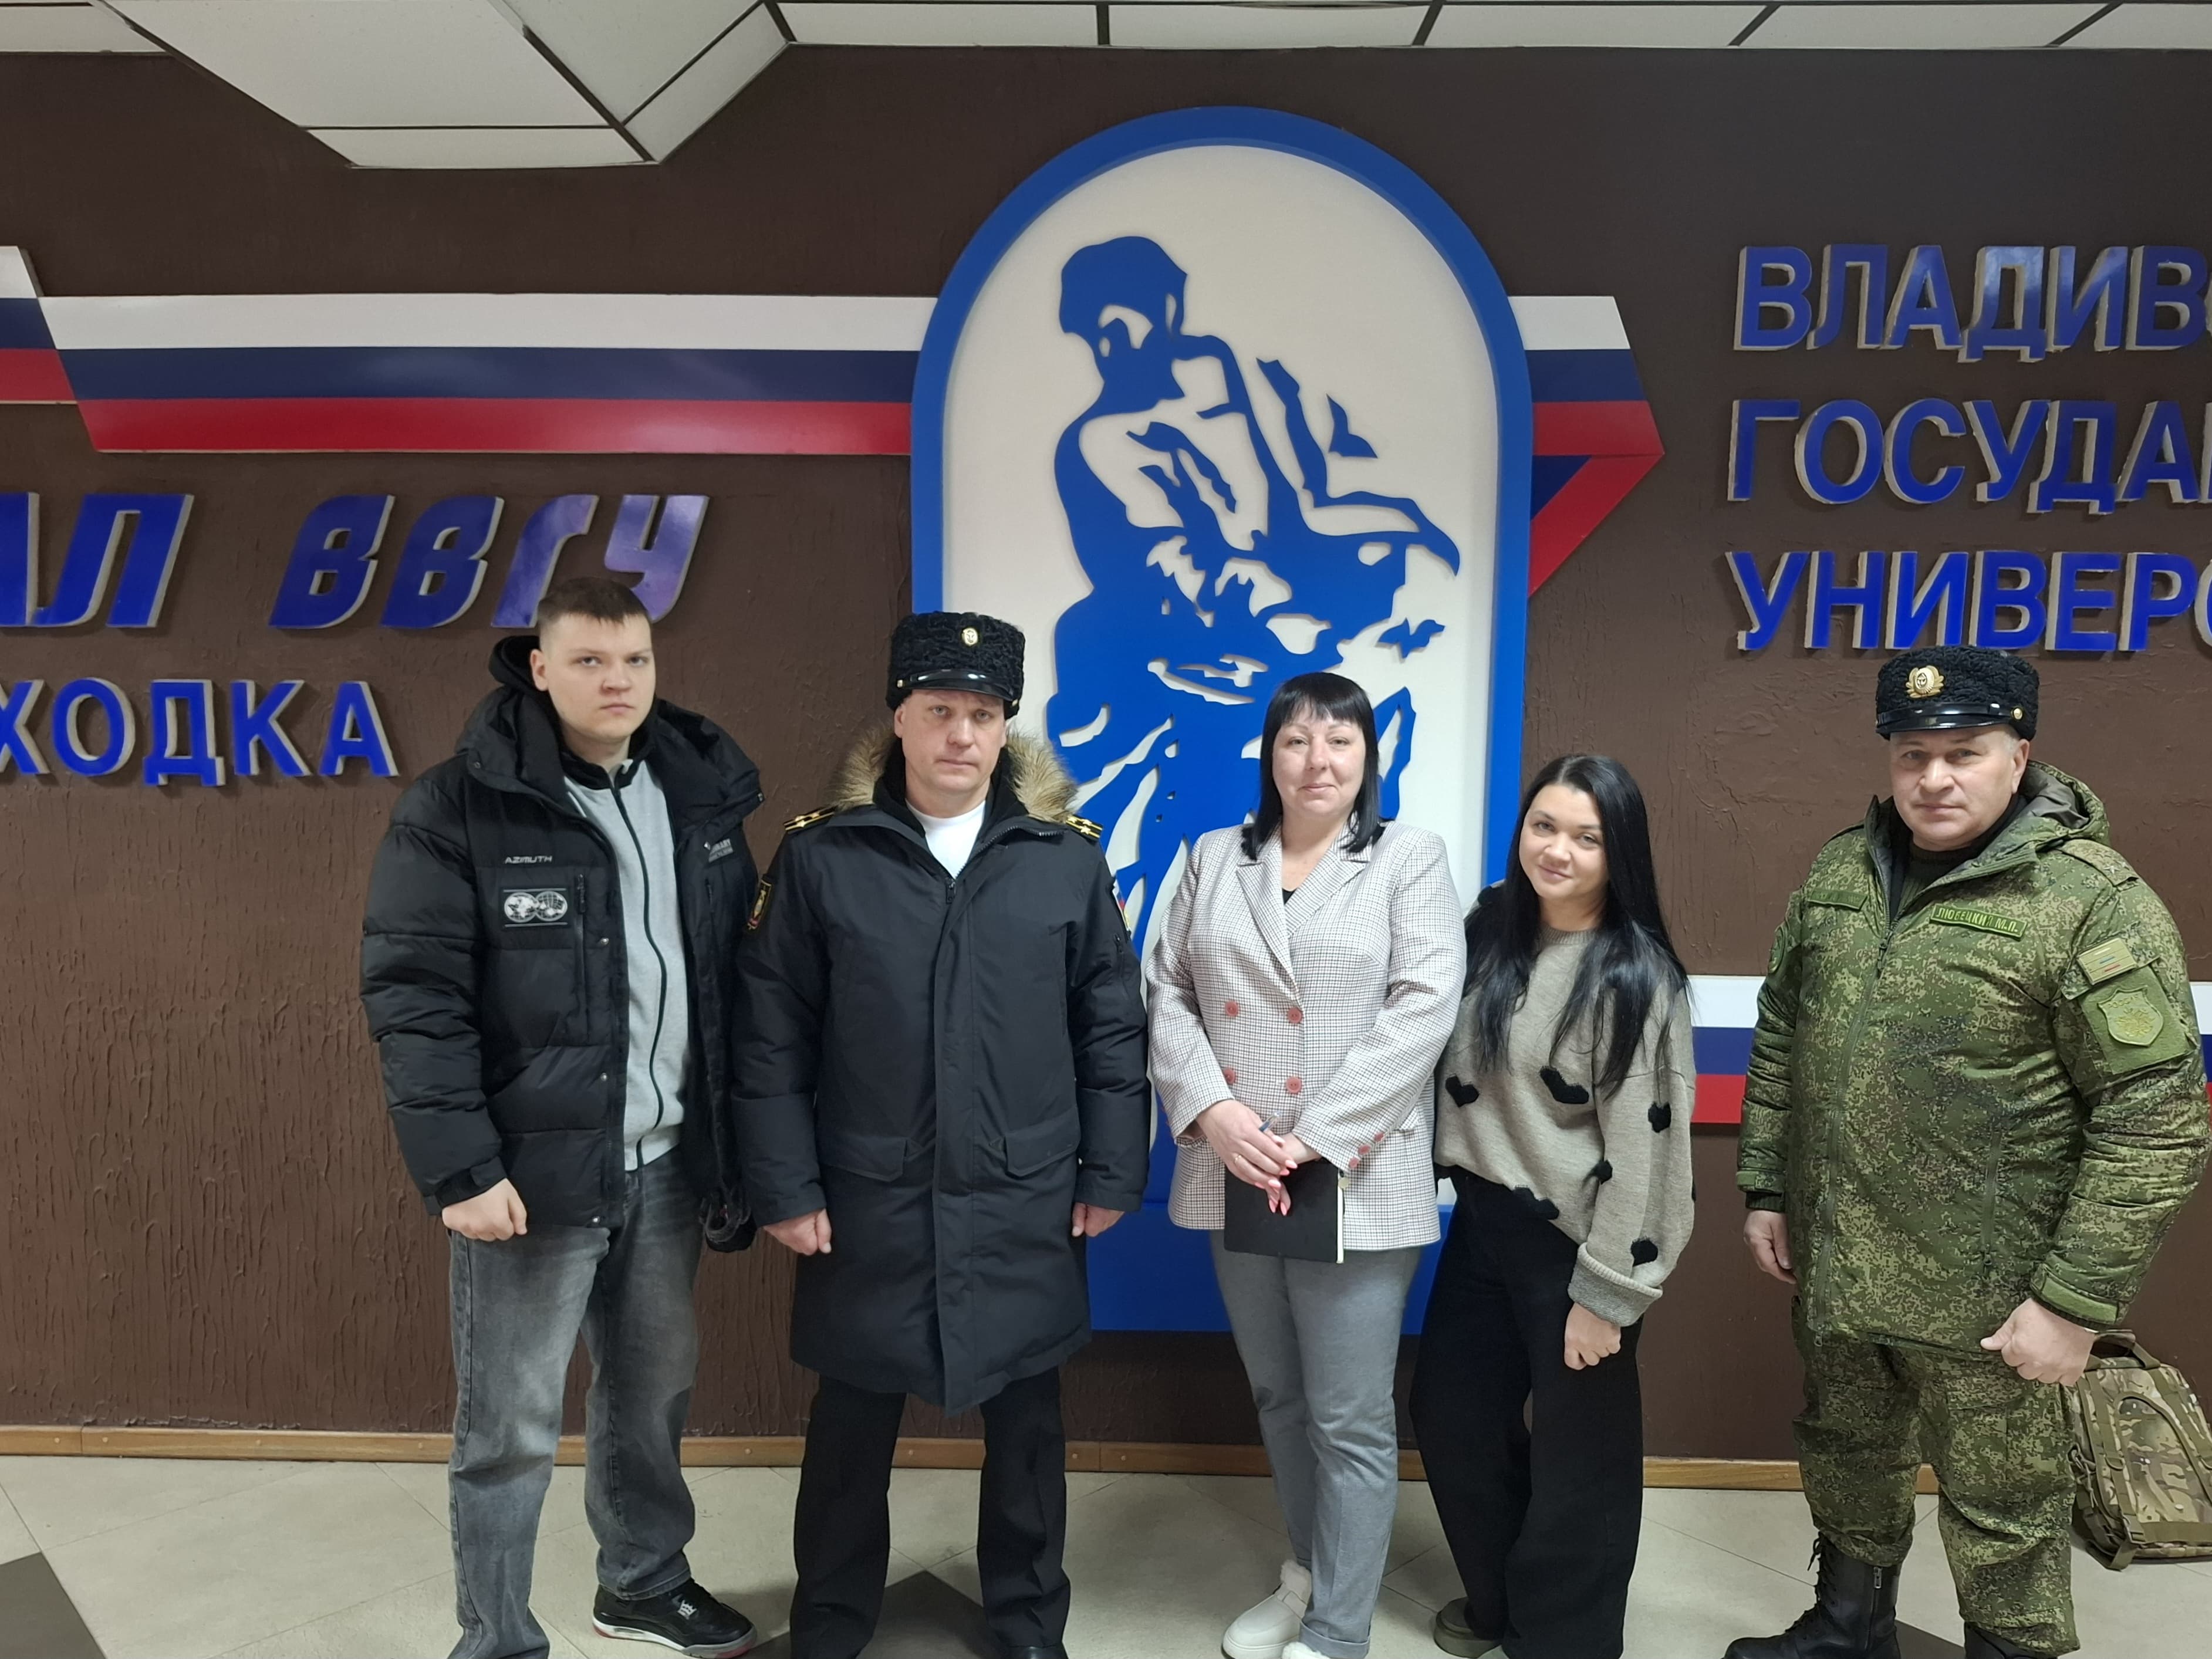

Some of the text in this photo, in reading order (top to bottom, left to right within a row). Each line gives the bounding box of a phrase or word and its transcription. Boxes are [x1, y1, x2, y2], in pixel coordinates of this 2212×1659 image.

[1733, 244, 2212, 363] ВЛАДИВ
[1727, 398, 2212, 515] ГОСУДА
[268, 494, 710, 629] ВВГУ
[1724, 549, 2212, 652] УНИВЕР
[504, 855, 553, 864] AZIMUTH
